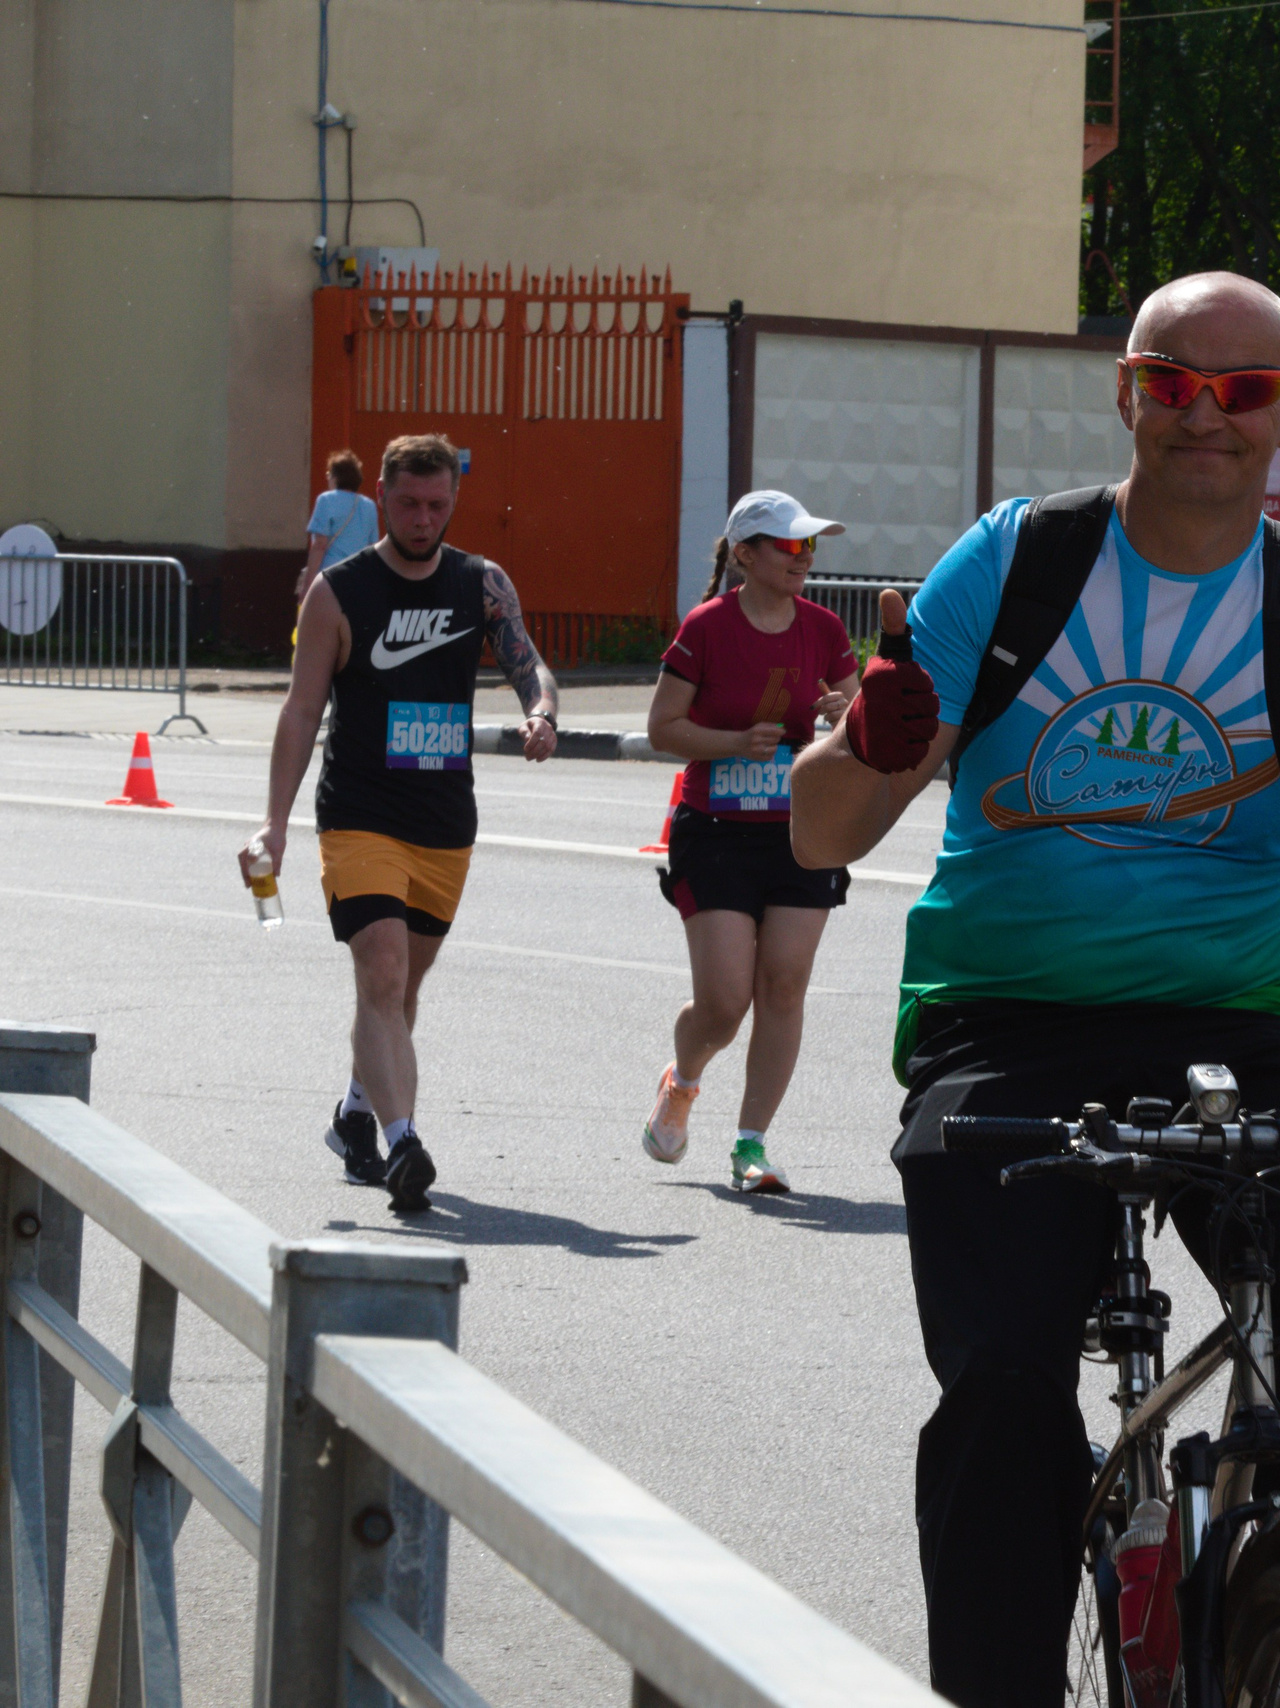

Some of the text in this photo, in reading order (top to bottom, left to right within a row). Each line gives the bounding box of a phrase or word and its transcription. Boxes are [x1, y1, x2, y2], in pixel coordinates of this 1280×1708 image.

[385, 609, 454, 643] NIKE
[392, 721, 465, 755] 50286
[417, 756, 444, 770] 10KM
[1096, 746, 1175, 768] РАМЕНСКОЕ
[714, 763, 791, 796] 50037
[1033, 743, 1233, 823] Сатурн
[739, 796, 768, 811] 10KM
